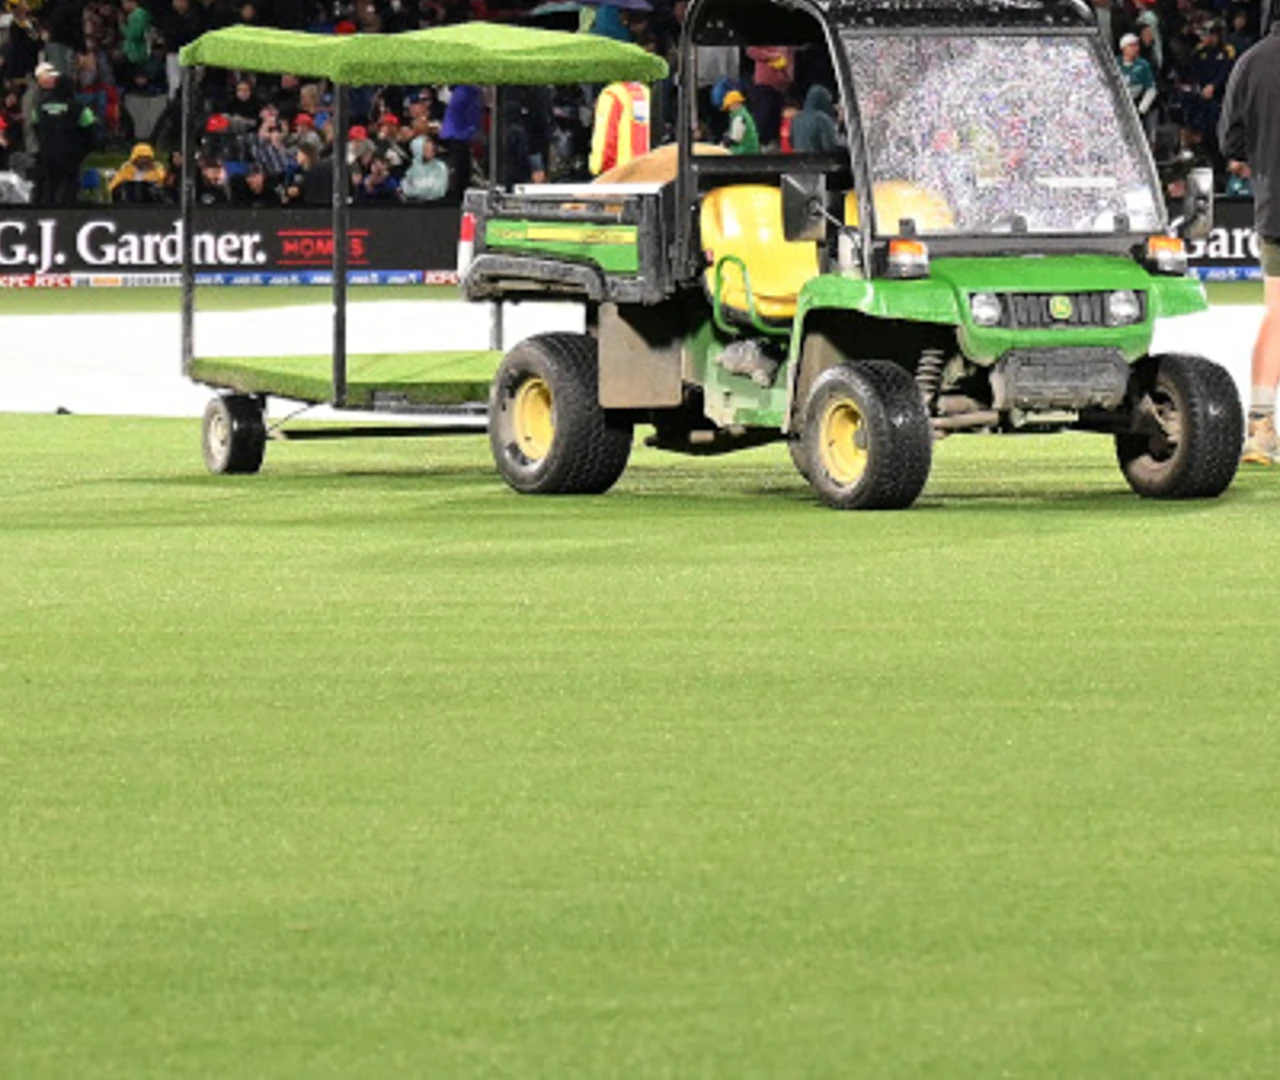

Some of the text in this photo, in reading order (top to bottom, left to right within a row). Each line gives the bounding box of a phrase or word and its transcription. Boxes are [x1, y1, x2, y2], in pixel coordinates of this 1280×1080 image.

[76, 219, 267, 266] Gardner.
[283, 237, 365, 258] HOMS
[34, 275, 72, 288] KFC
